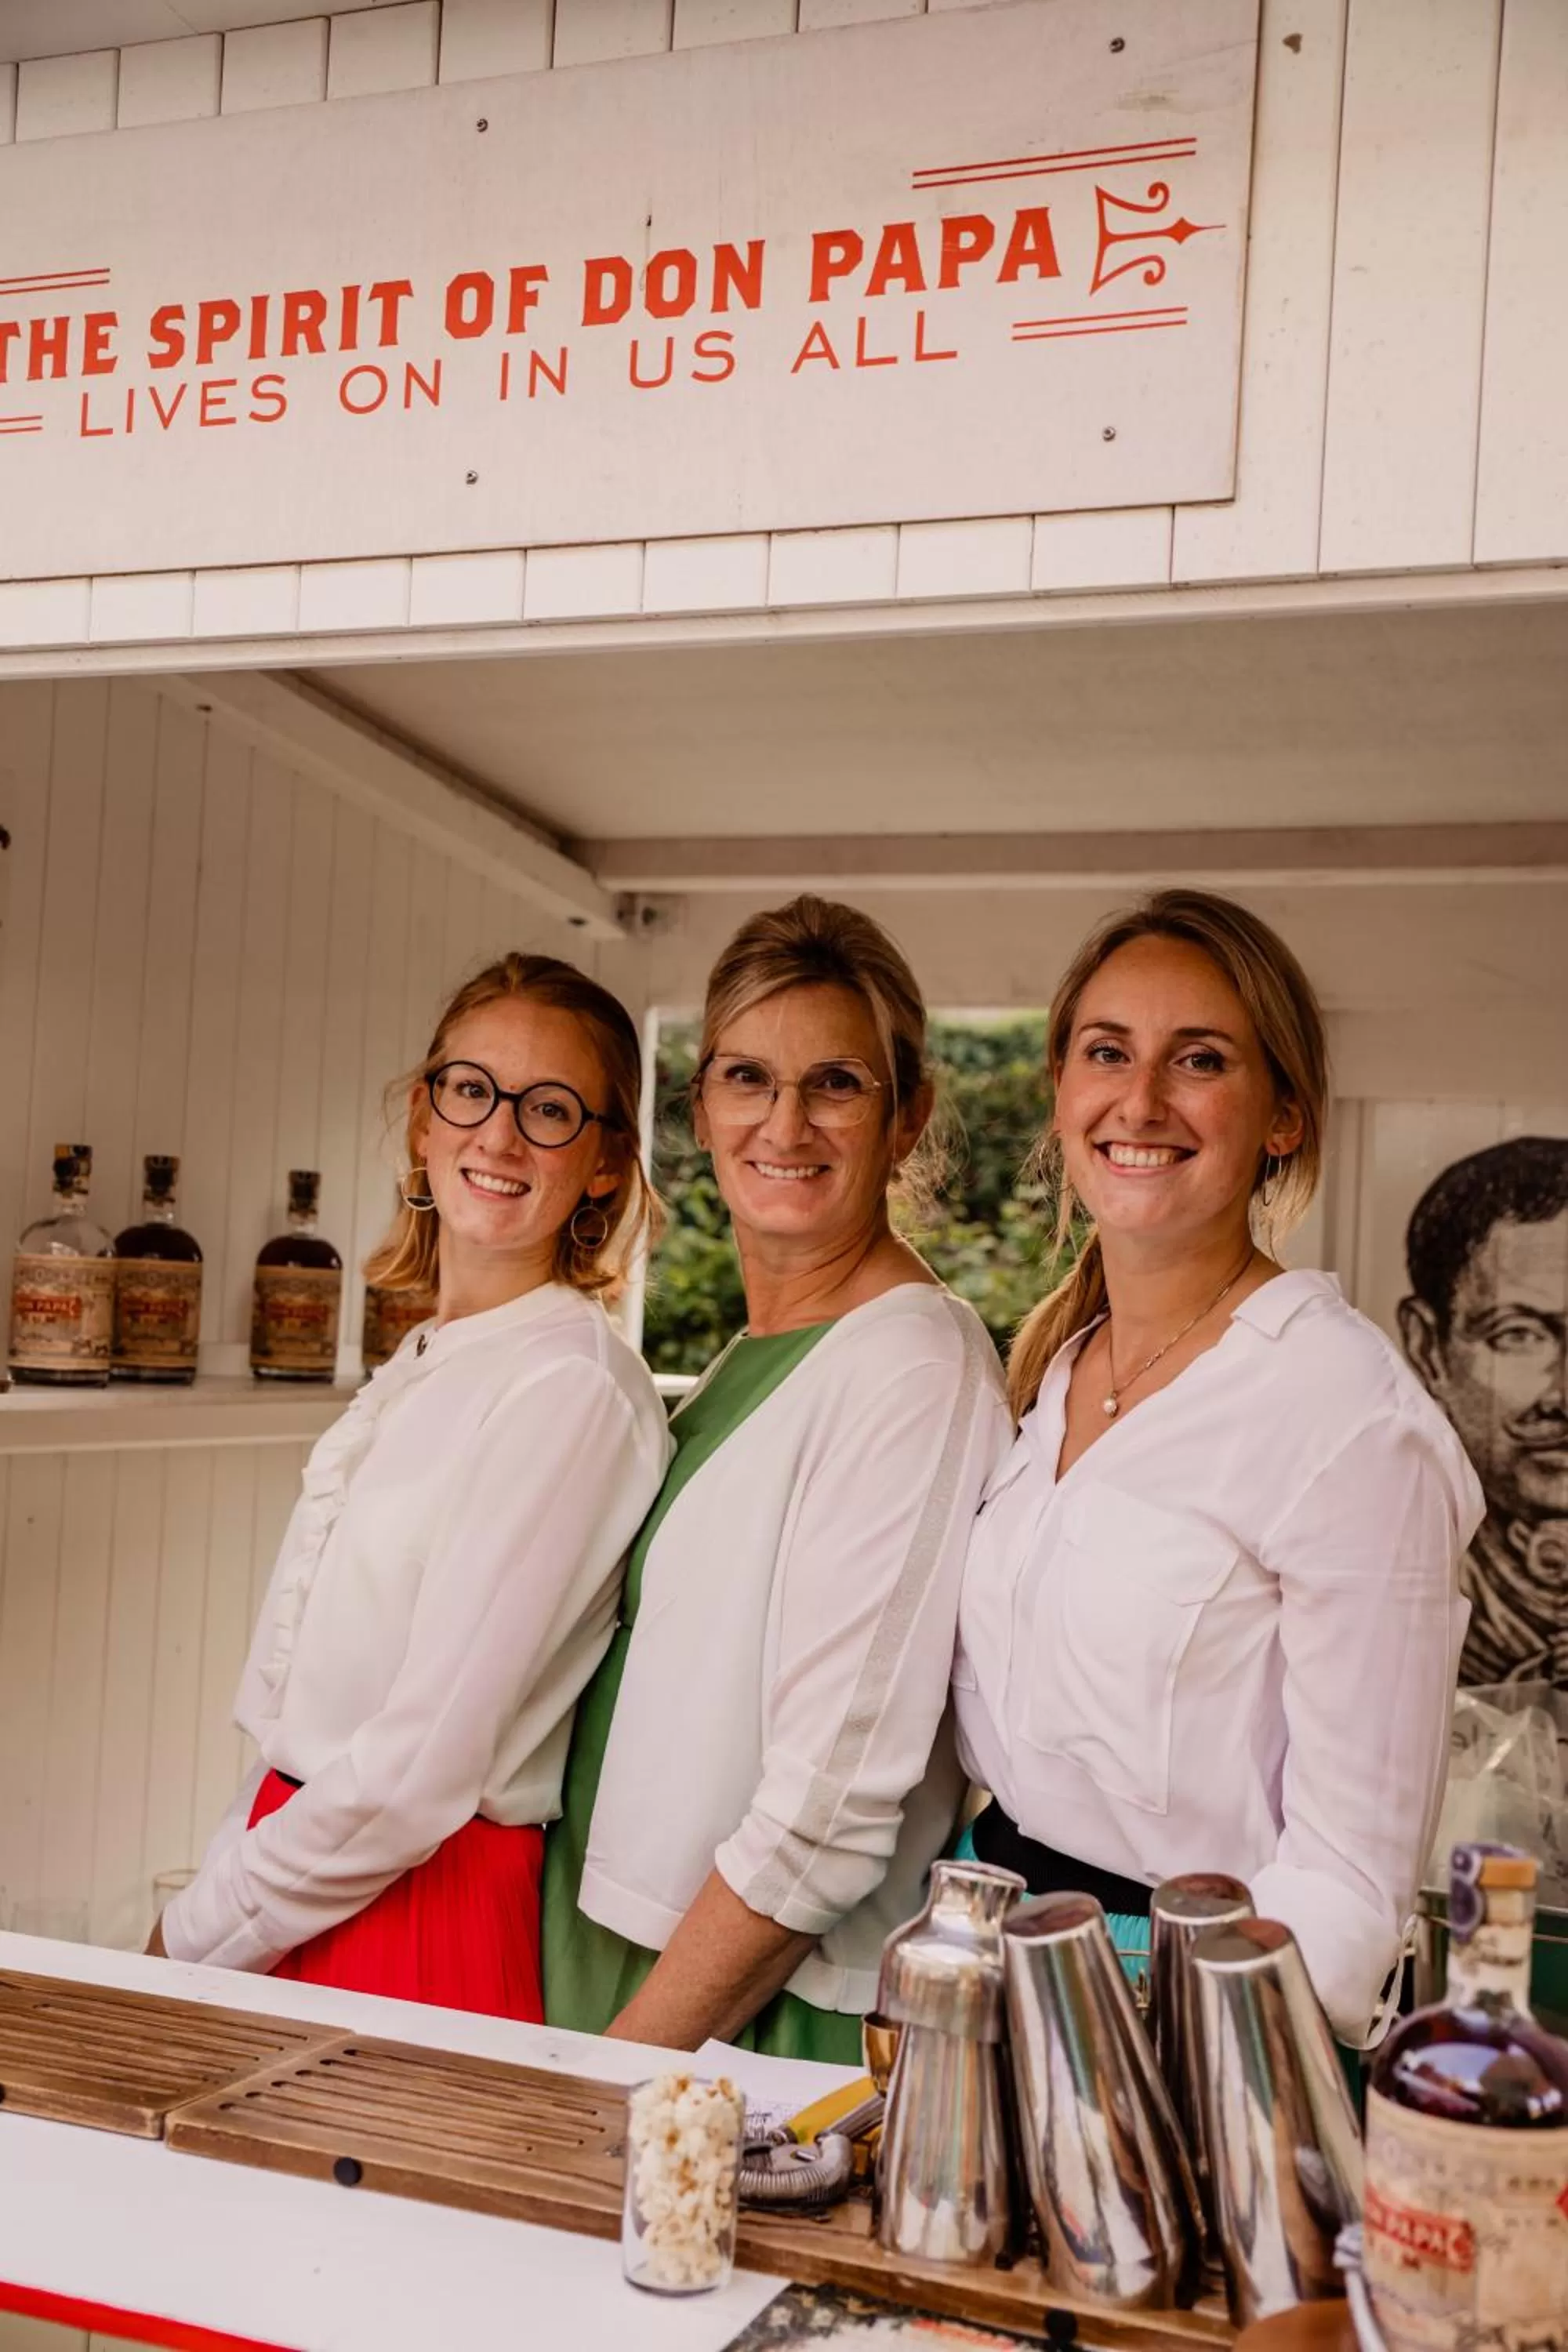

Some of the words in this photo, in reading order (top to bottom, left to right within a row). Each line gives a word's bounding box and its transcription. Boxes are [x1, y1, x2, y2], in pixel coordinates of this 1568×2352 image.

[147, 278, 415, 371] SPIRIT
[443, 263, 551, 340] OF
[581, 237, 766, 328] DON
[808, 205, 1062, 304] PAPA
[78, 372, 289, 438] LIVES
[338, 358, 443, 416] ON
[499, 346, 569, 402] IN
[628, 329, 737, 390] US
[790, 308, 960, 376] ALL
